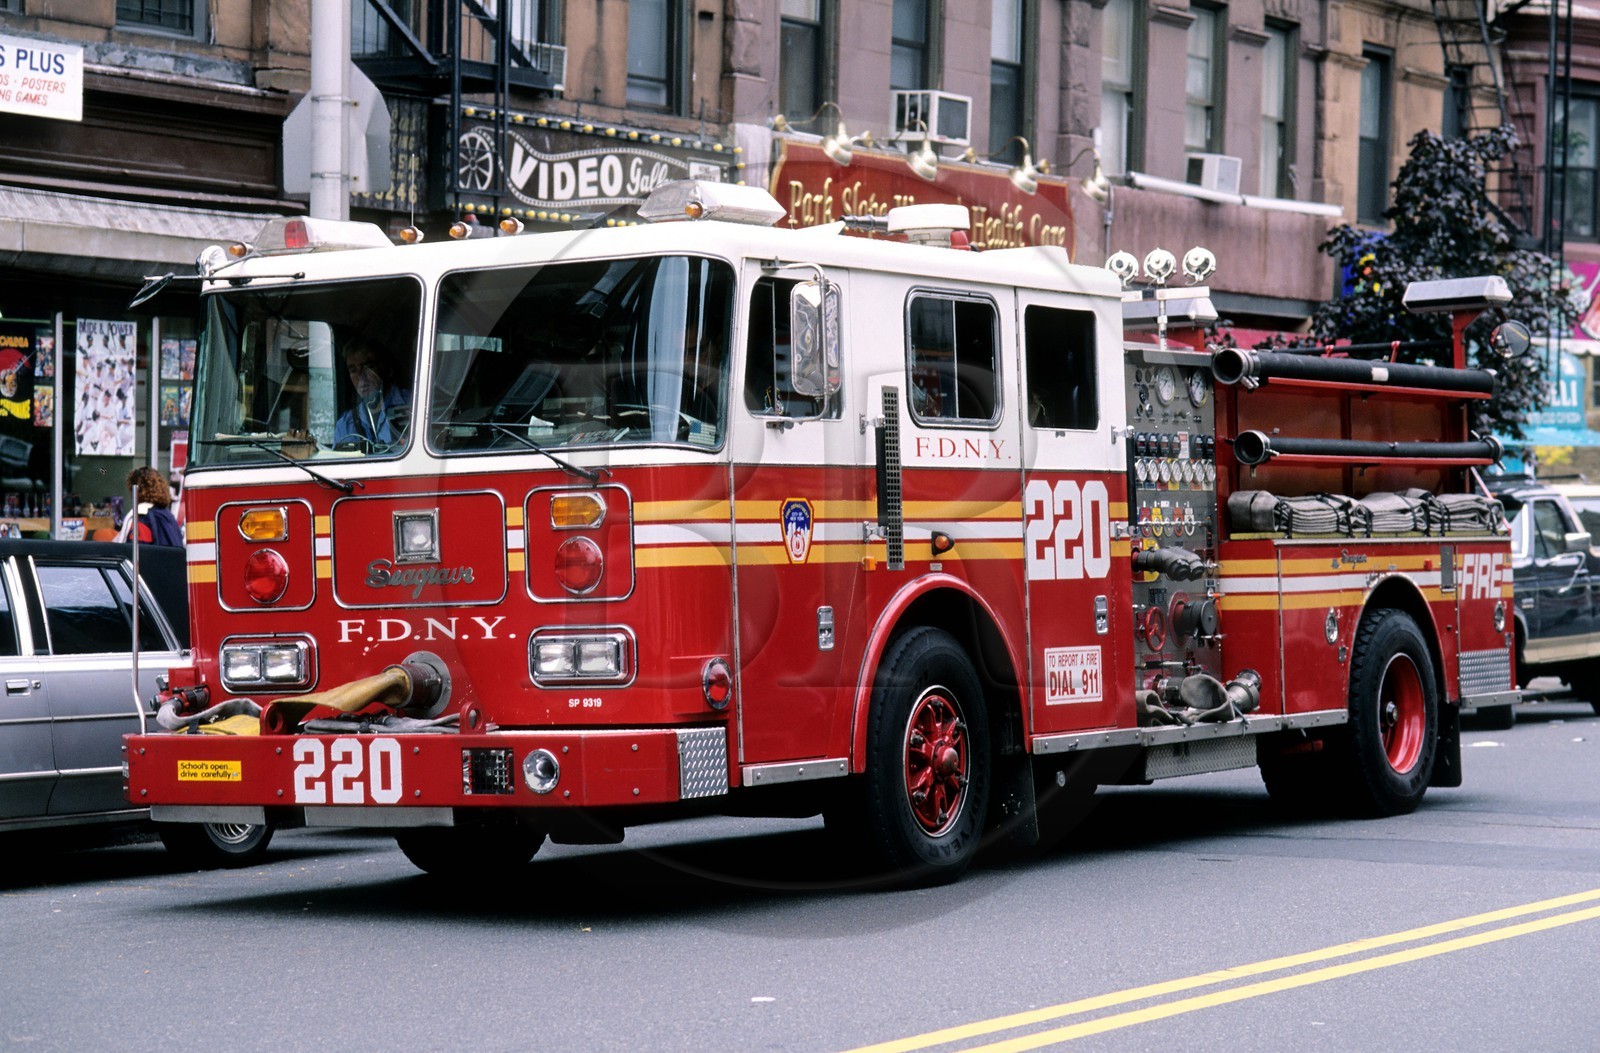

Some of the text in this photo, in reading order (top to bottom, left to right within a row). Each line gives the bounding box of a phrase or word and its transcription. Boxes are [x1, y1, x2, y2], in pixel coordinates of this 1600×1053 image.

[16, 48, 65, 75] PLUS
[15, 91, 48, 107] GAMES
[21, 77, 66, 94] POSTERS
[510, 142, 623, 201] VIDEO
[788, 177, 836, 226] Park
[971, 202, 1025, 249] Health
[915, 436, 1012, 459] F.D.N.Y.
[1025, 480, 1111, 581] 220
[365, 558, 475, 599] Seagrave
[1461, 553, 1503, 600] FIRE
[337, 616, 516, 643] F.D.N.Y.
[1049, 652, 1098, 668] TO REPORT A FIRE
[1049, 669, 1099, 697] DIAL 911
[568, 697, 602, 708] SP 9319
[180, 762, 209, 770] School's
[180, 770, 232, 780] drive carefully
[293, 738, 402, 804] 220
